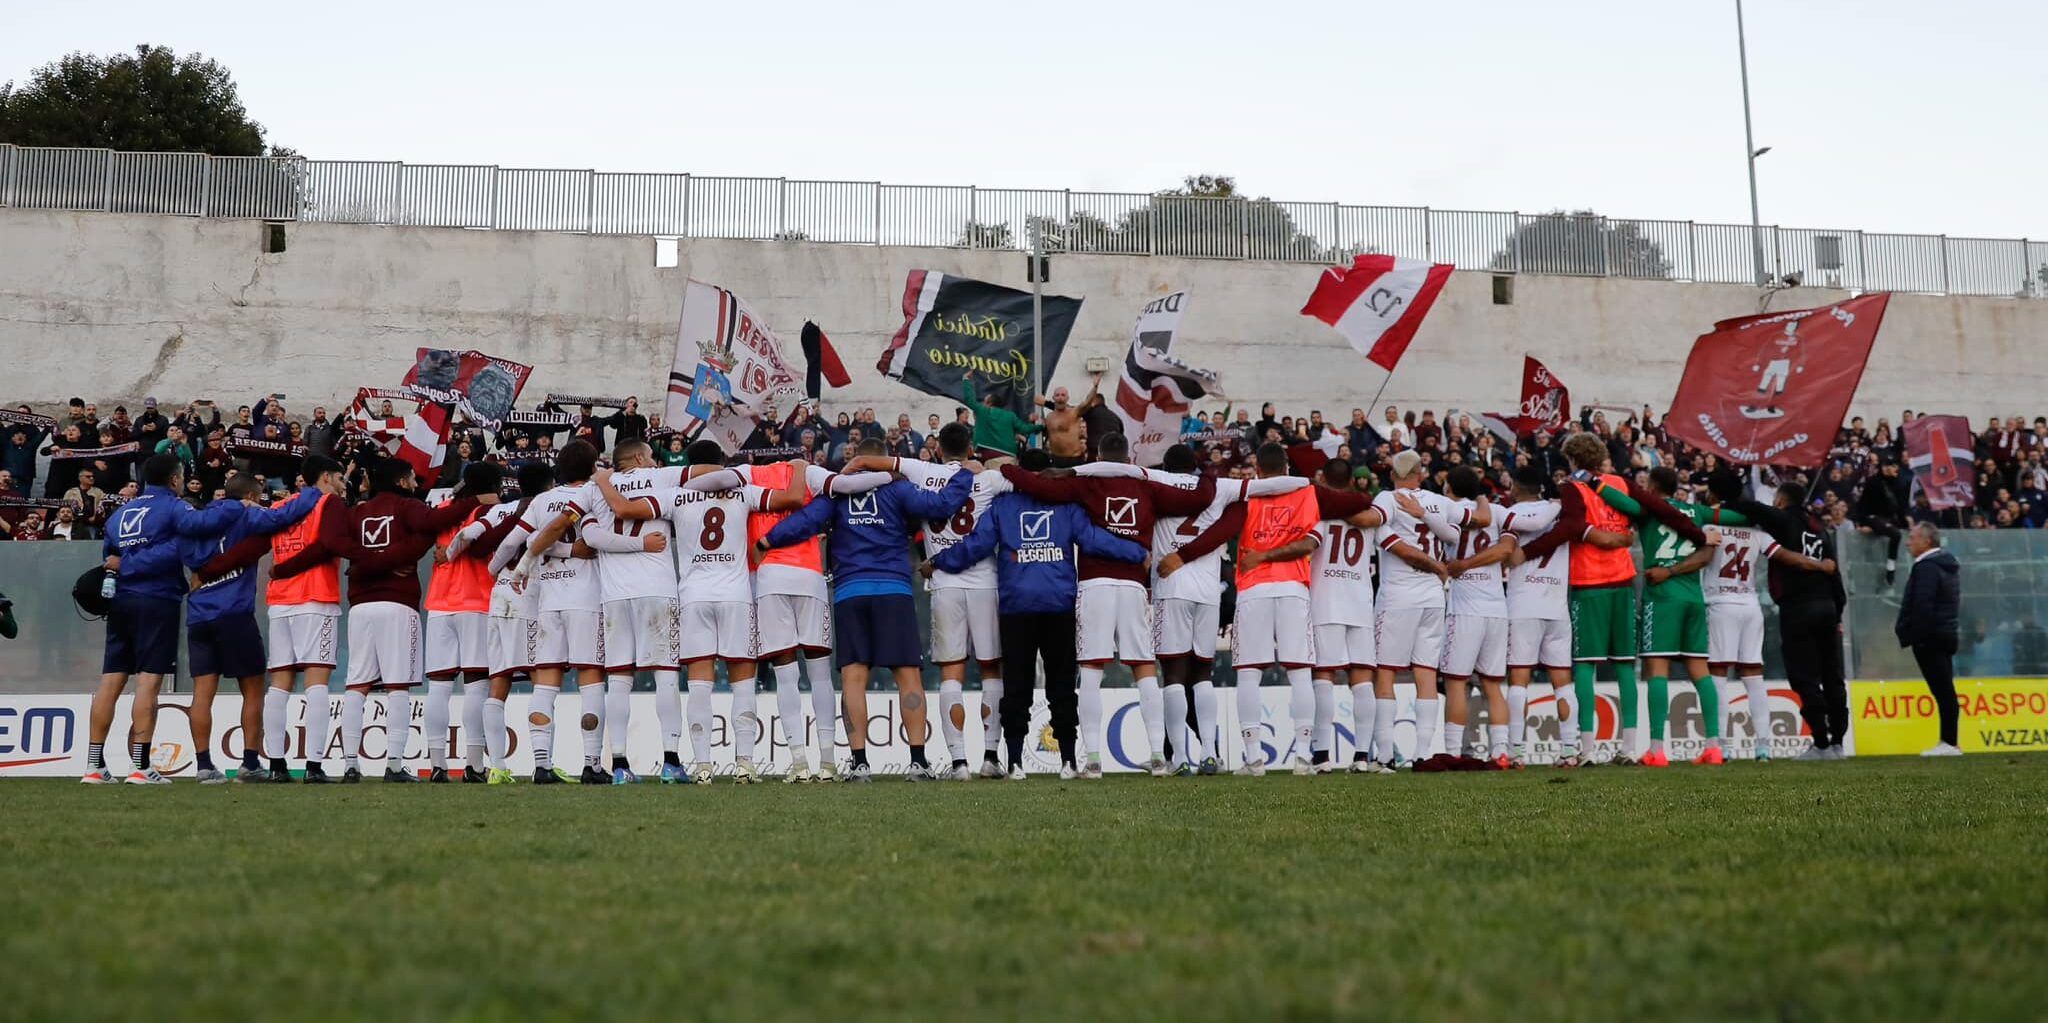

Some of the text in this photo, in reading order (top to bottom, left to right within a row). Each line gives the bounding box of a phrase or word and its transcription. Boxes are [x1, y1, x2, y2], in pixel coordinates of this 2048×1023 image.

[235, 437, 287, 451] REGGINA
[700, 506, 726, 551] 8
[848, 517, 885, 525] GIVOVA
[1328, 524, 1364, 567] 10
[1719, 543, 1750, 581] 24
[1863, 693, 2048, 719] AUTORASPO
